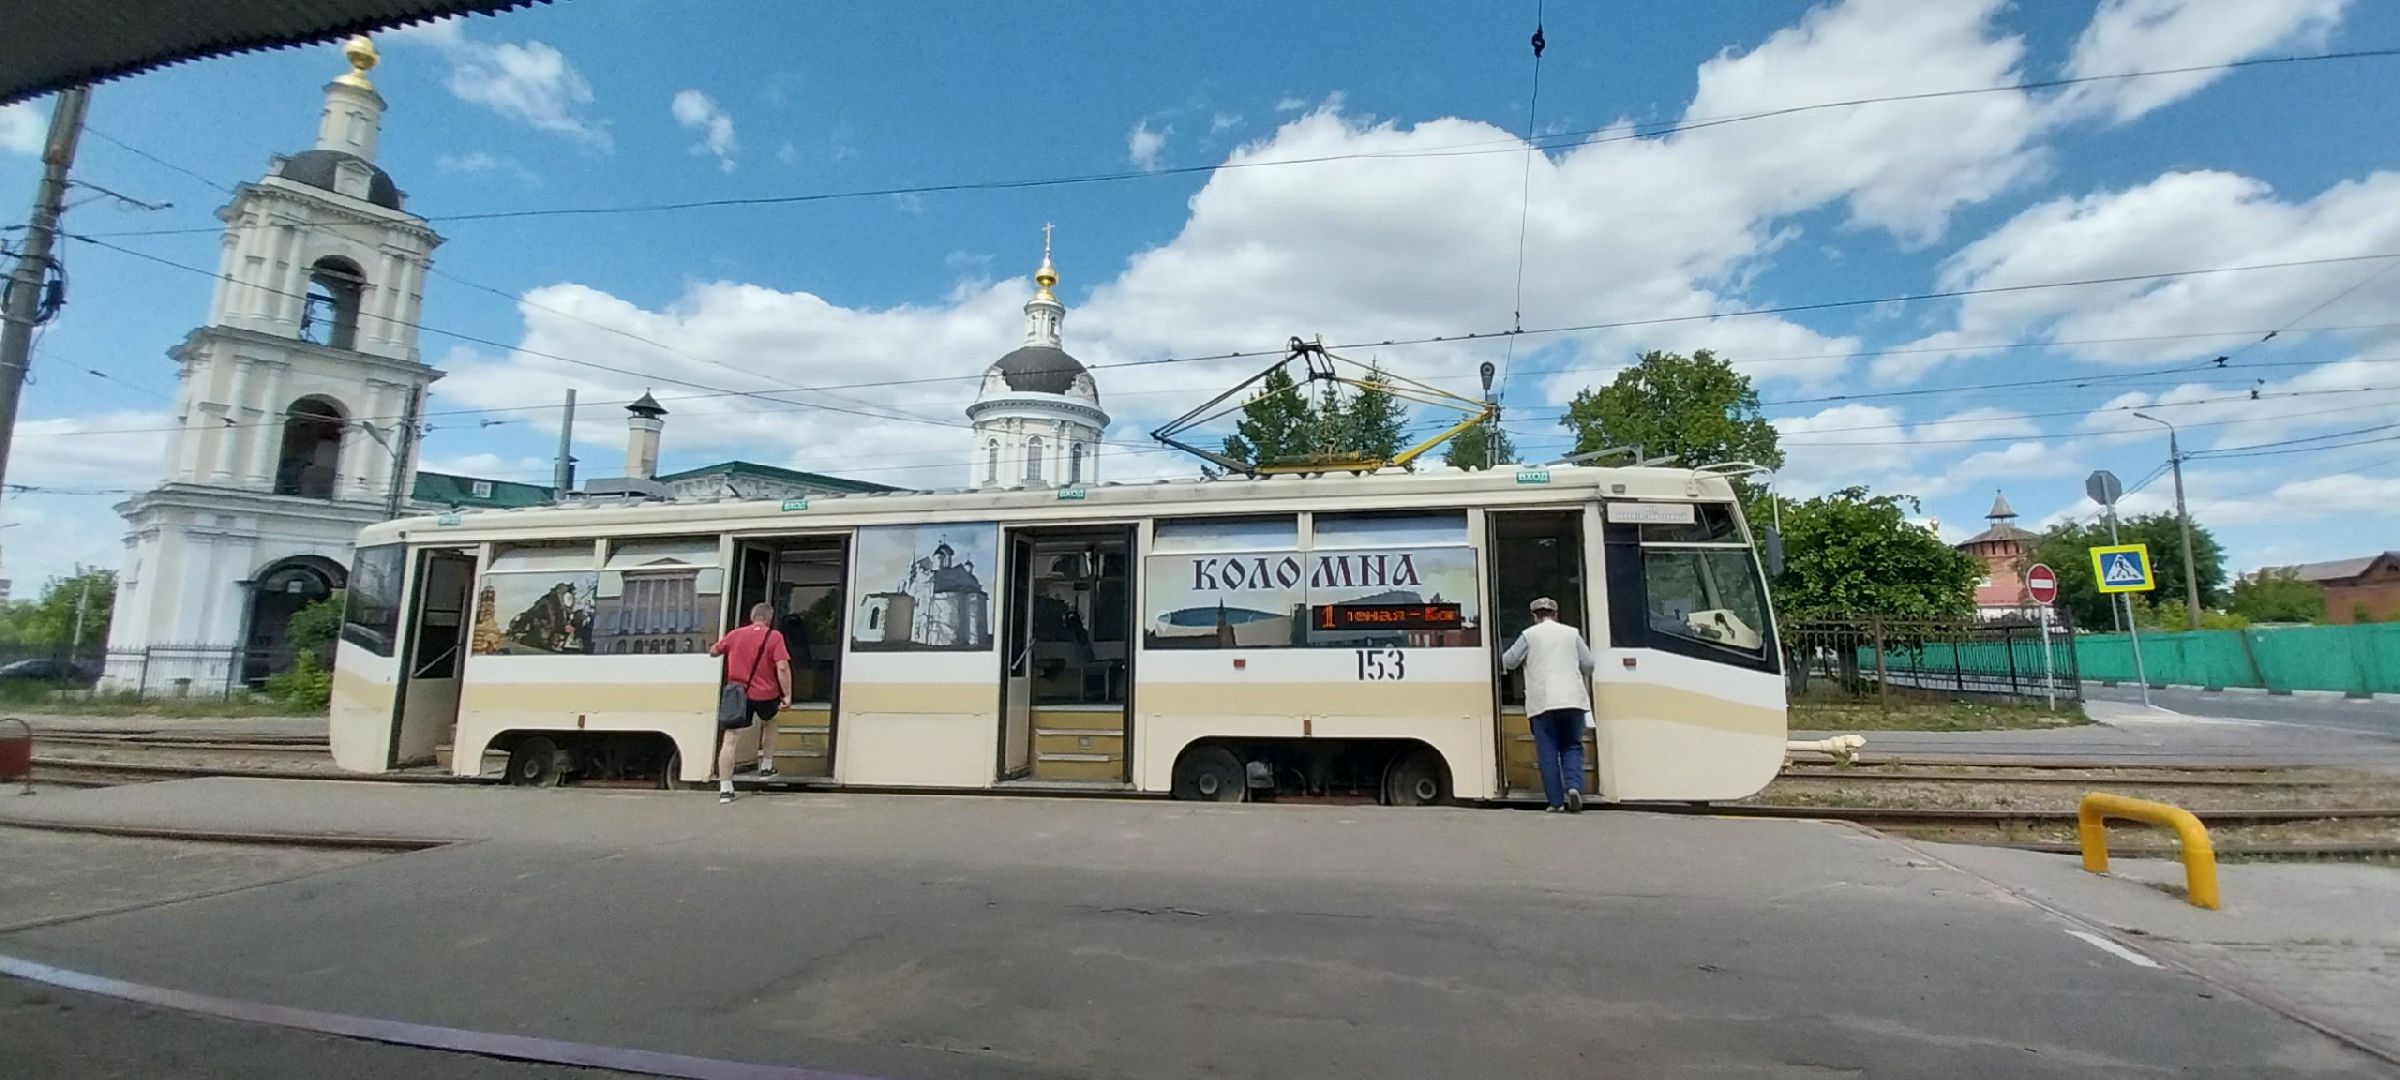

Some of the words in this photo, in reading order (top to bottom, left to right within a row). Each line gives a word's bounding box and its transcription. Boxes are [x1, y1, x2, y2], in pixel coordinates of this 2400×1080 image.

[1518, 472, 1548, 481] ВХОД
[1192, 554, 1422, 590] КОЛОМНА
[1322, 605, 1335, 628] 1
[1356, 650, 1405, 680] 153
